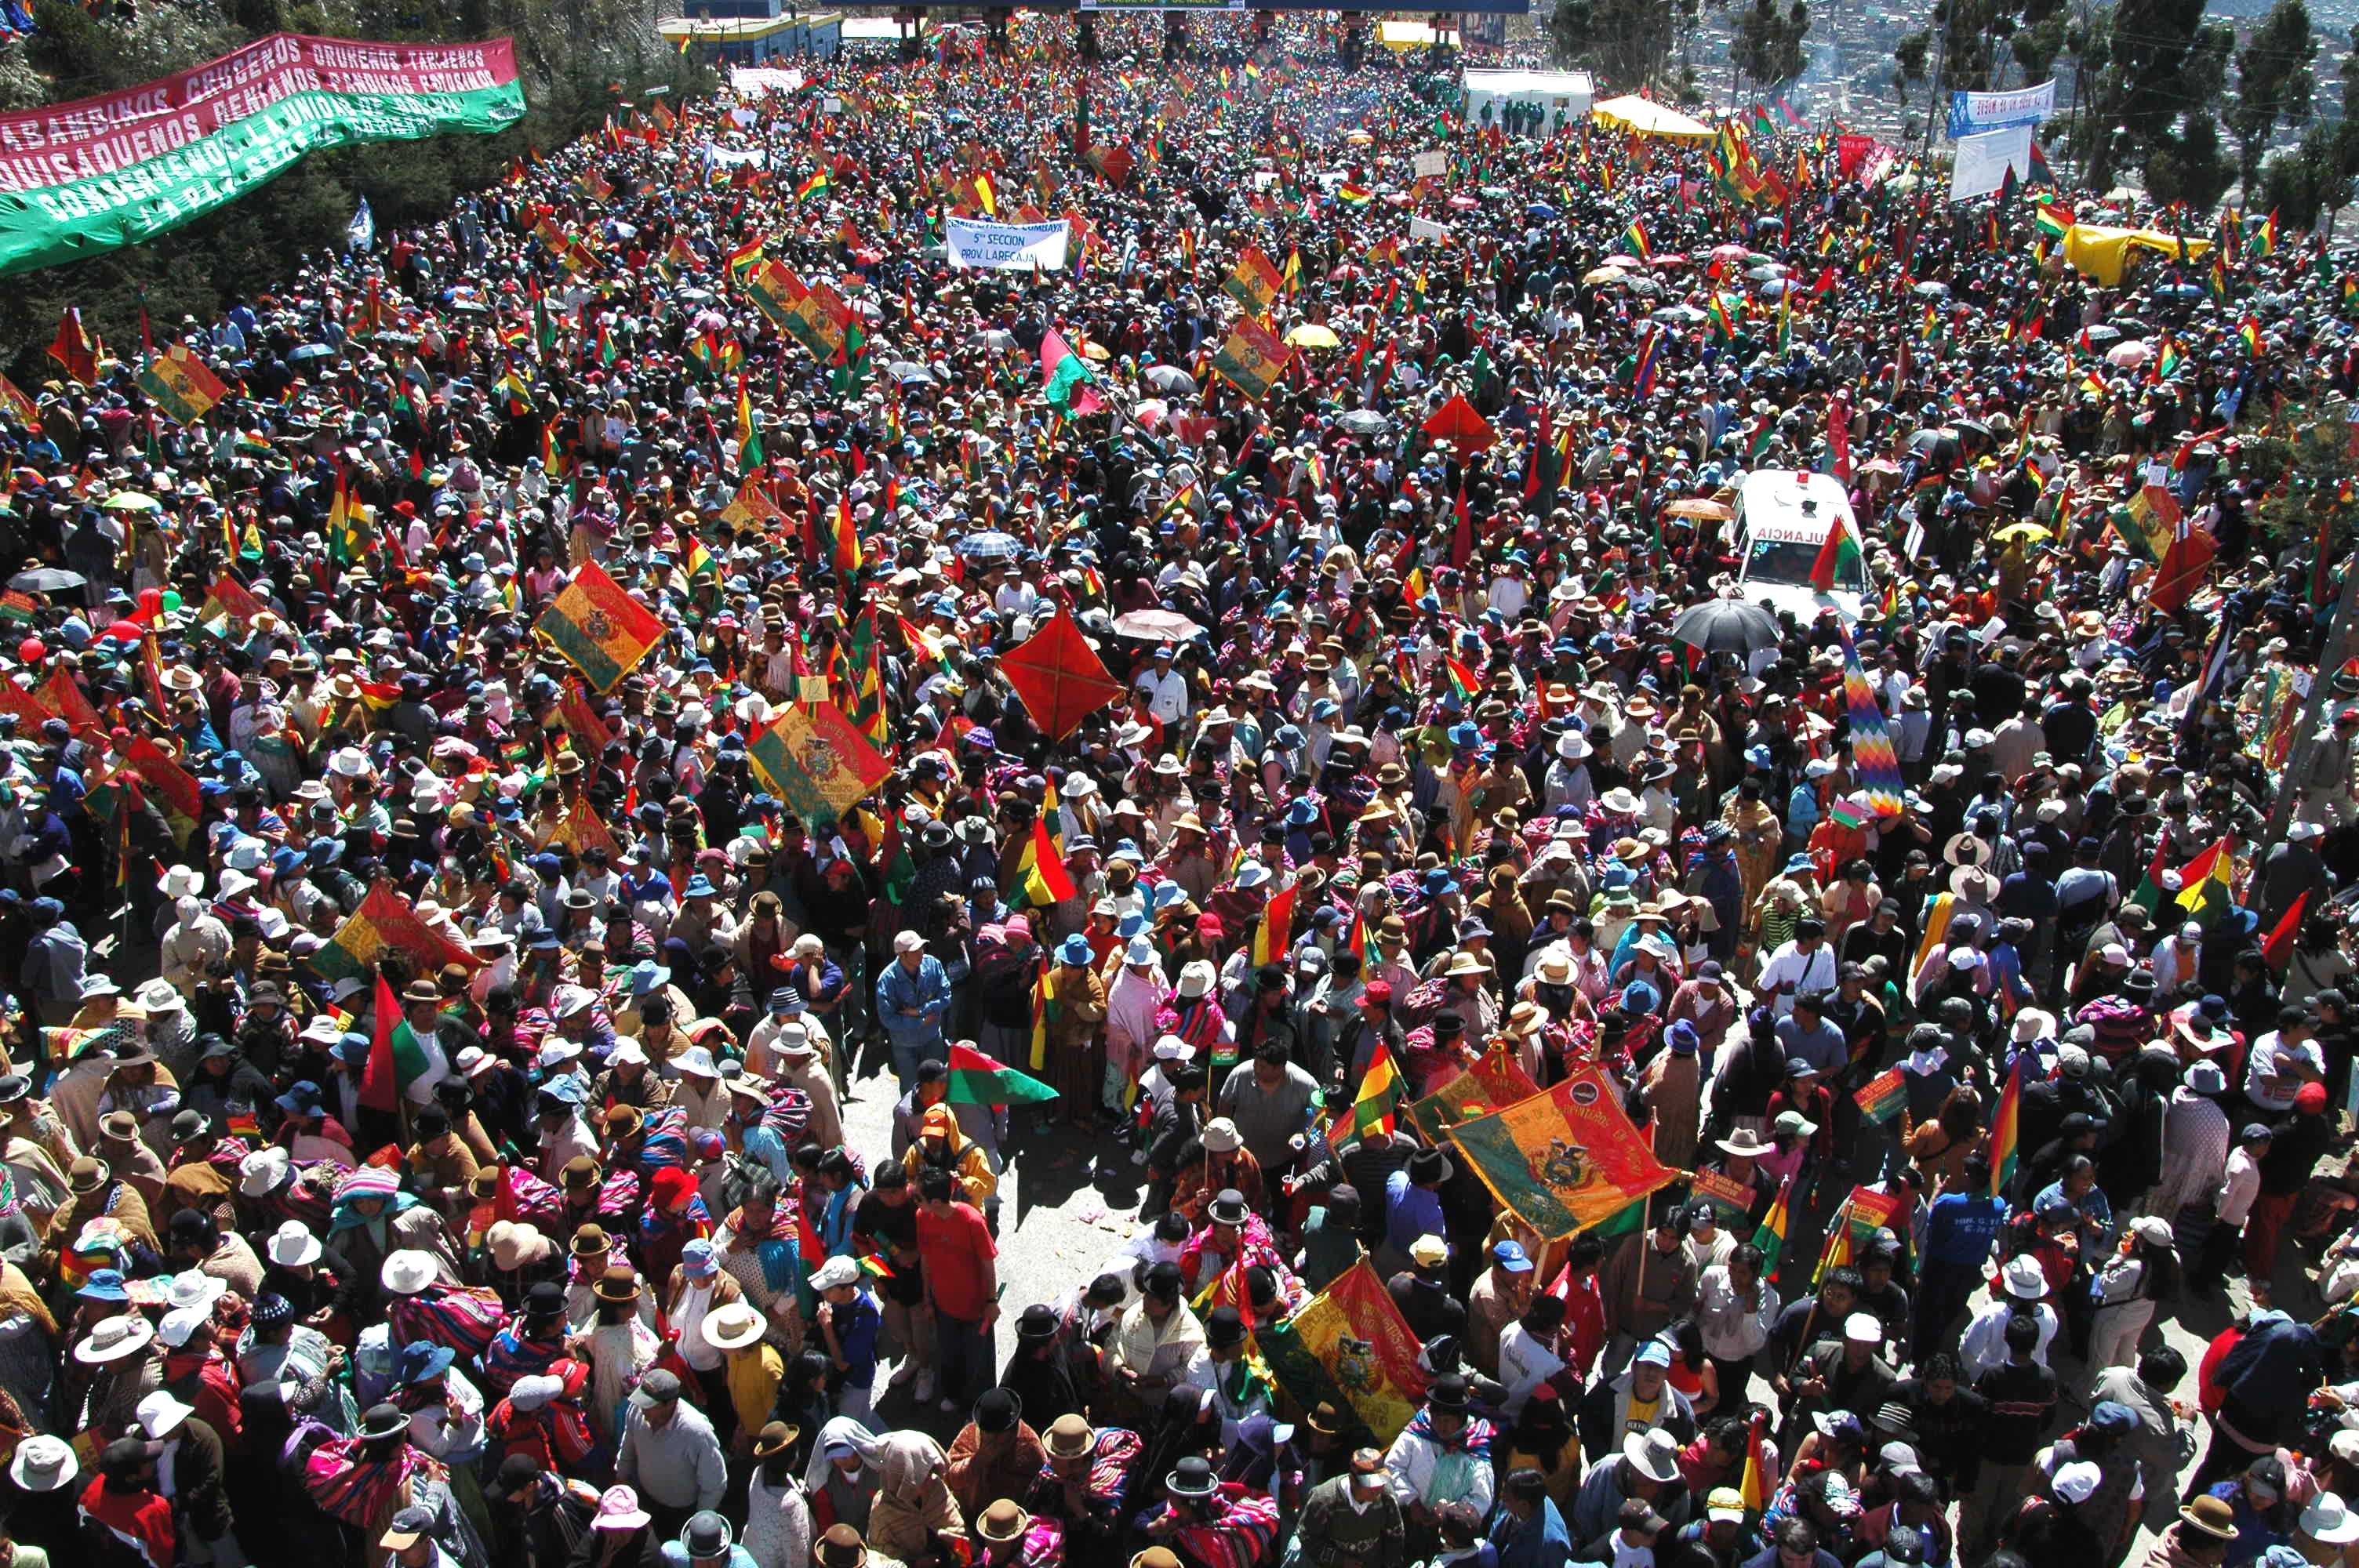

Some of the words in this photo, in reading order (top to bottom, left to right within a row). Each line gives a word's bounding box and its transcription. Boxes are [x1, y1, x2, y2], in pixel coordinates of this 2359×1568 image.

[328, 71, 414, 94] PANDINOS
[419, 69, 496, 93] POTOSINOS
[38, 135, 243, 221] CONSERVEMOS
[245, 115, 285, 146] LA
[281, 95, 356, 126] UNIDAD
[987, 234, 1025, 246] SECCION
[986, 250, 1036, 263] LARECAJA
